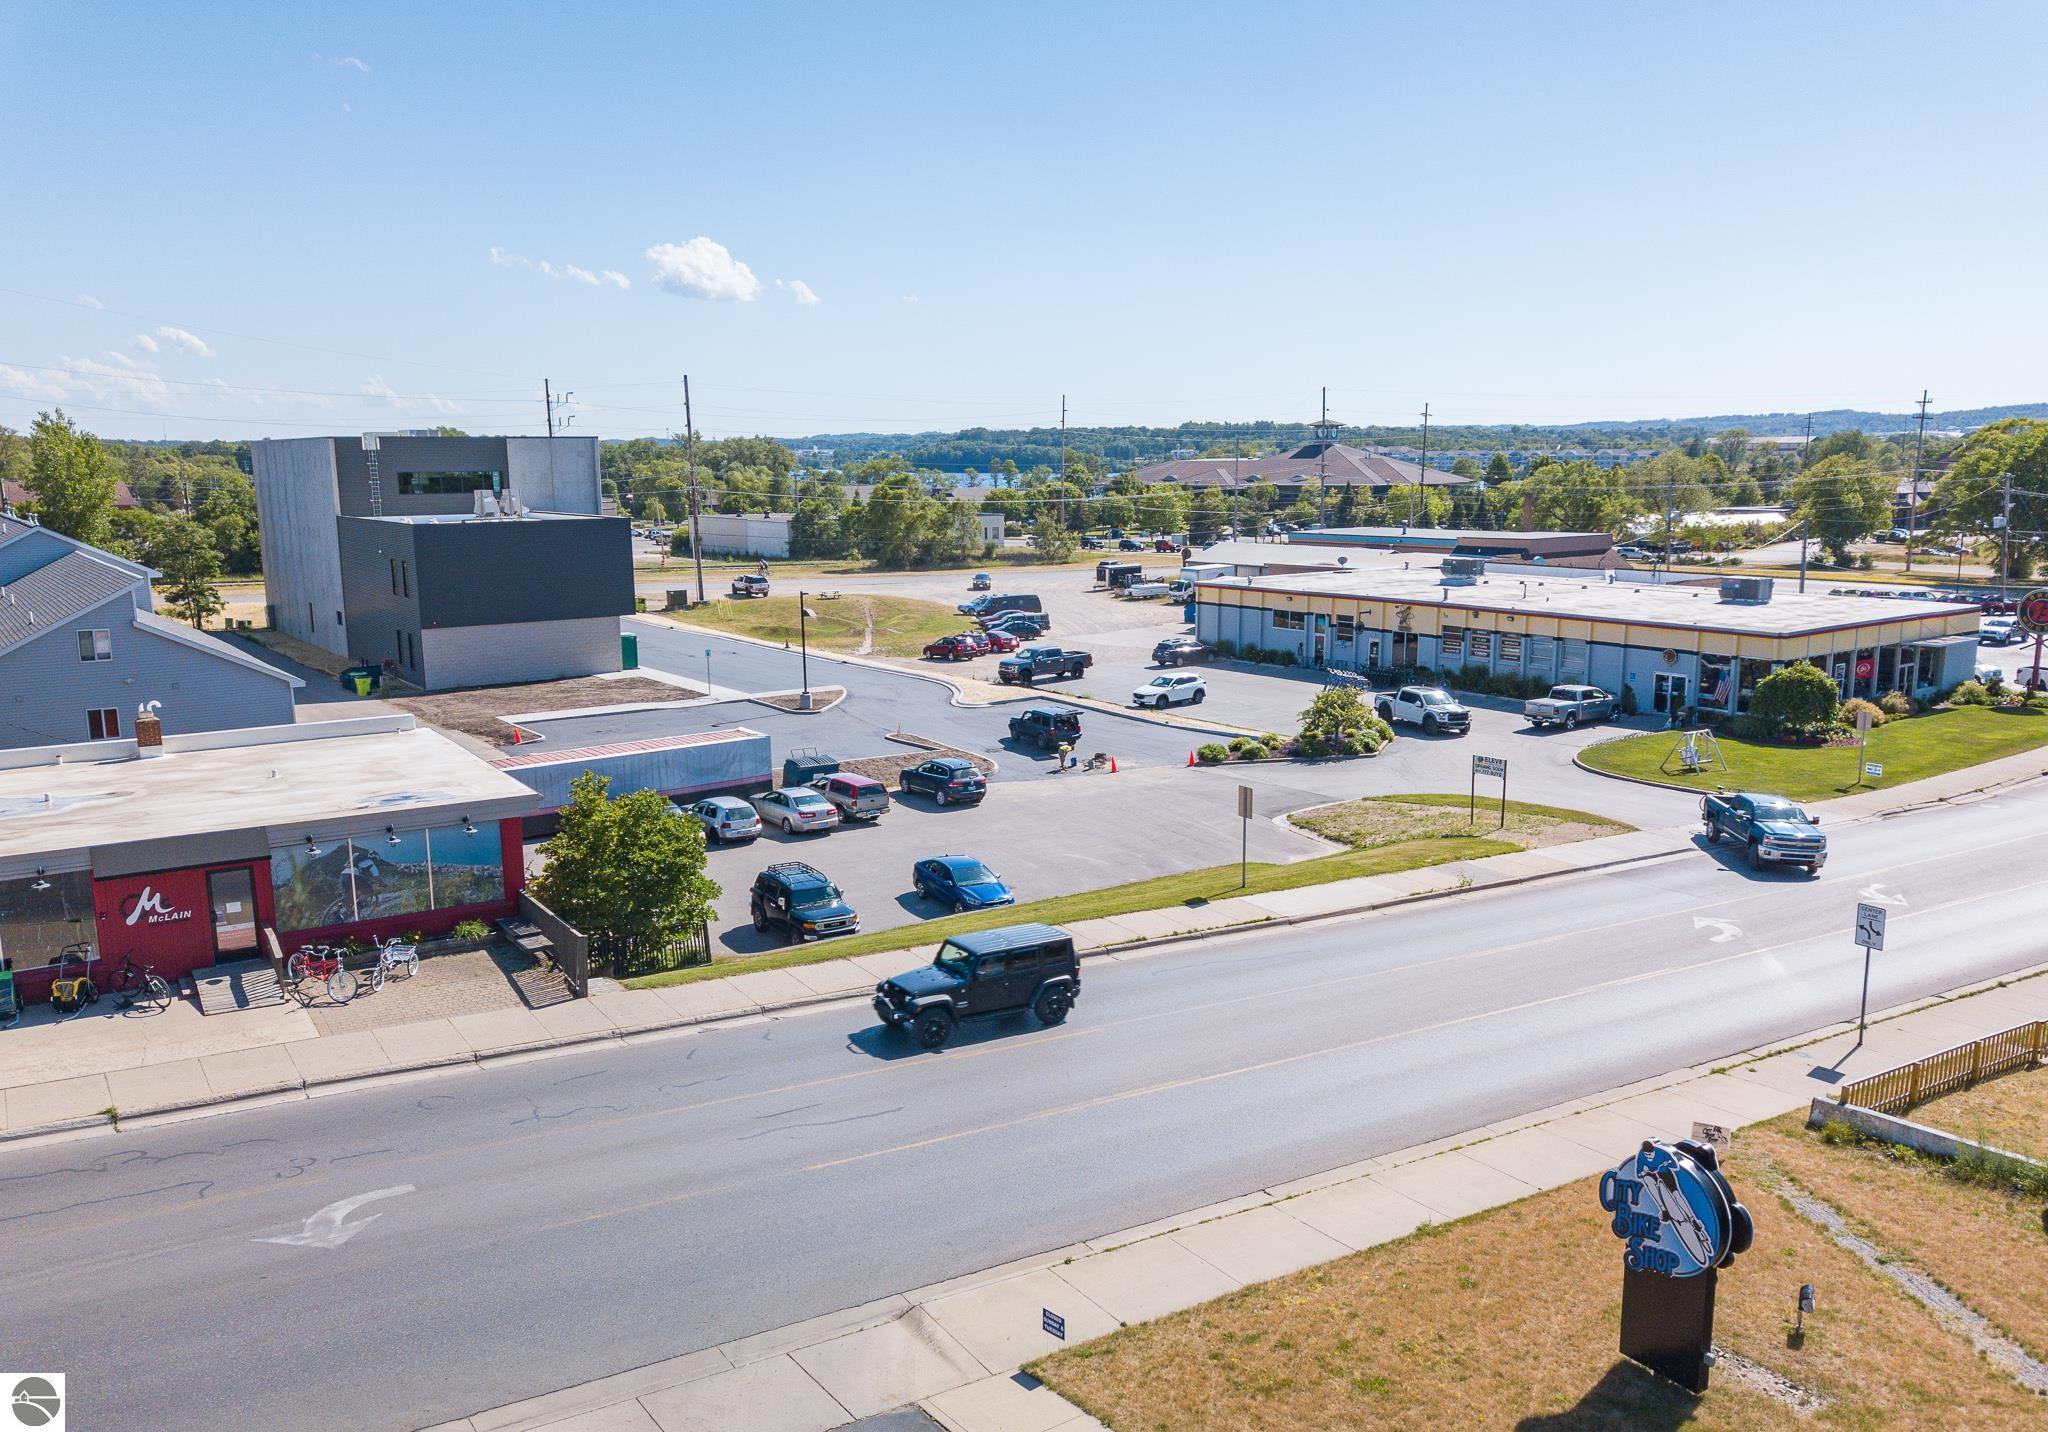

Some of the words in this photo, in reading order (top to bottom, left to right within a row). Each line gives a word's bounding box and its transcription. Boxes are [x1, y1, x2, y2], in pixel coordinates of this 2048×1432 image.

[1861, 906, 1883, 915] CENTER
[1599, 1167, 1643, 1212] CITY
[1612, 1202, 1662, 1243] BIKE
[1623, 1236, 1681, 1275] SHOP
